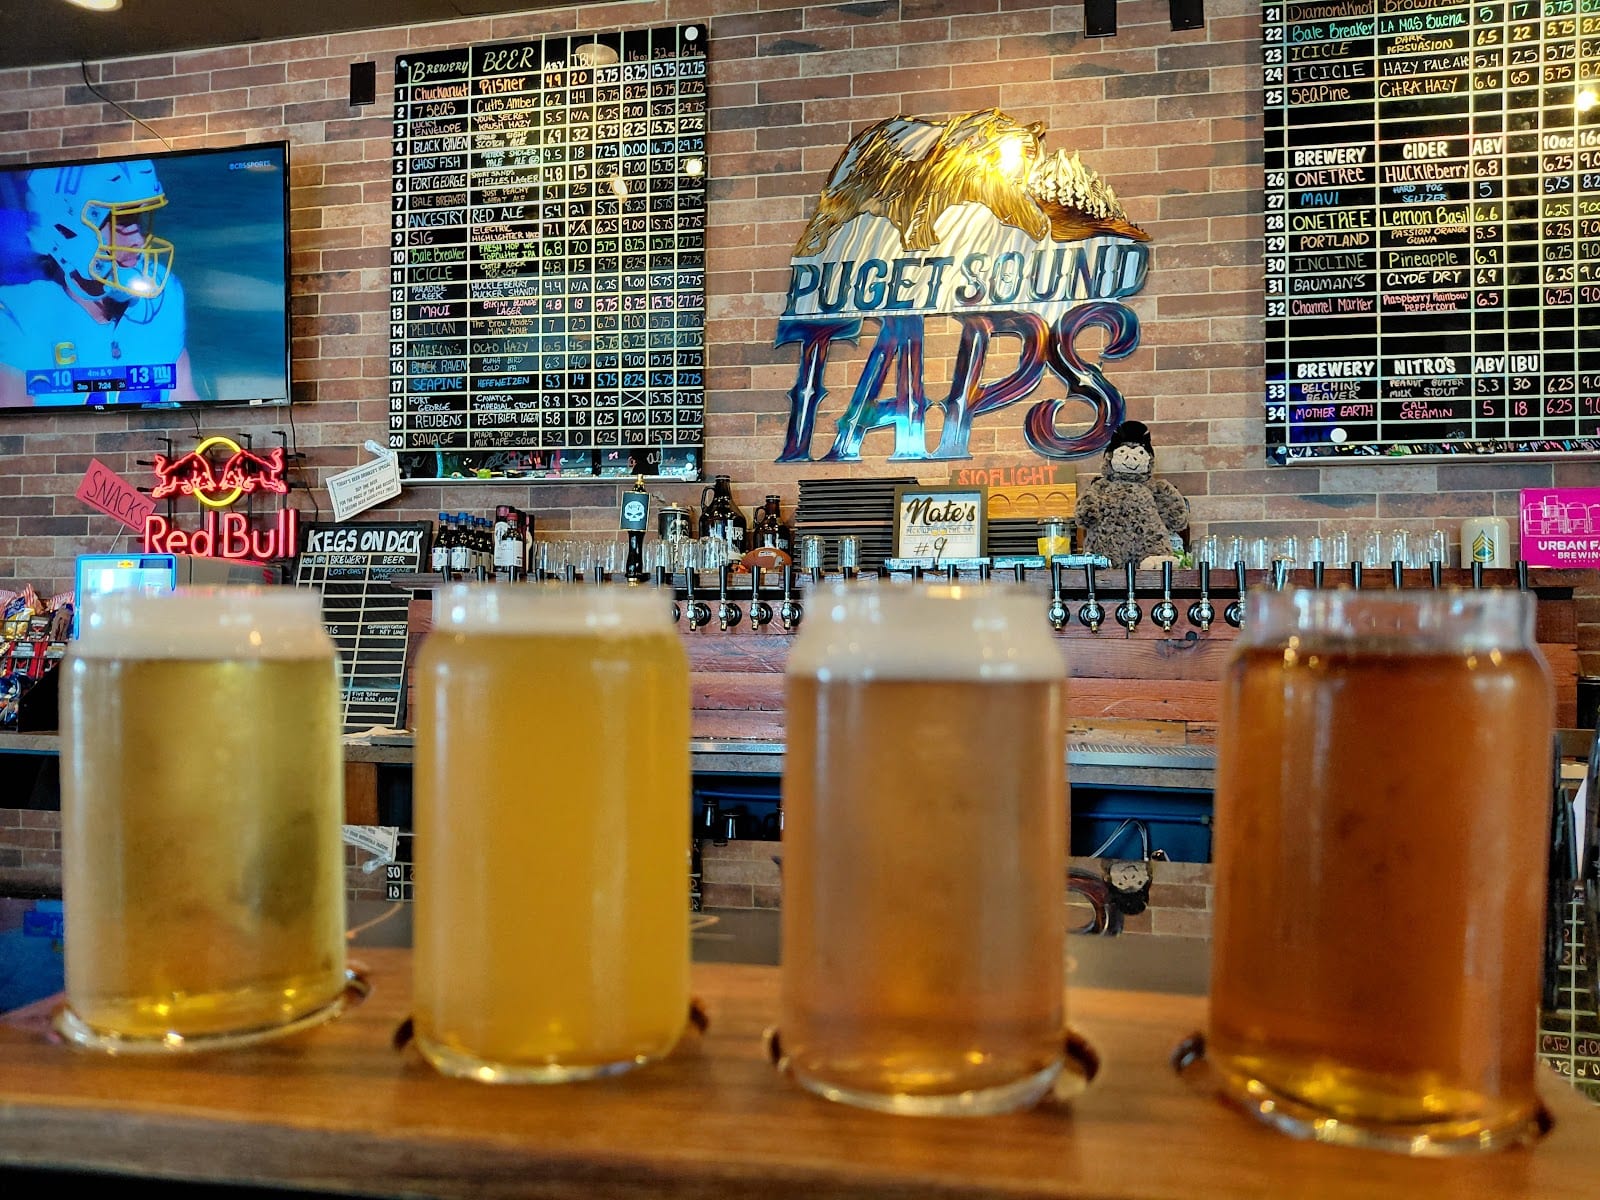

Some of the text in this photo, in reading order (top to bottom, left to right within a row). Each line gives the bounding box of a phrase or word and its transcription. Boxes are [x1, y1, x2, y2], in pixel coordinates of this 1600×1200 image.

[1265, 4, 1528, 42] 22 Bale LA 5 17
[1266, 8, 1280, 21] 21
[1265, 26, 1531, 63] 23 ICICLE PERSUASION 22
[1395, 34, 1425, 45] DARK
[483, 46, 534, 72] BEER
[1265, 50, 1538, 82] 24 ICICLE HAZY 25
[397, 71, 588, 101] 1 Chuckanut 20
[1265, 71, 1529, 104] 25 HAZY 65
[397, 90, 586, 119] 2 44
[396, 122, 462, 137] 3 ENVELOPE
[395, 142, 403, 155] 4
[414, 139, 441, 154] BLACK
[443, 136, 469, 152] RAVEN
[572, 127, 589, 141] 32
[1294, 146, 1367, 167] BREWERY
[1402, 141, 1448, 160] CIDER
[1473, 137, 1503, 156] ABV
[396, 156, 461, 174] 5 GHOST FISH
[395, 180, 404, 192] 6
[411, 176, 432, 191] FORT
[432, 172, 466, 189] GEORGE
[1266, 173, 1285, 187] 26
[395, 197, 404, 210] 7
[412, 195, 434, 208] BALE
[436, 194, 467, 207] BREAKER
[1267, 182, 1493, 208] 27 MAUI 5
[395, 204, 585, 228] 8 ANCESTRY RED ALE 21
[1266, 206, 1470, 231] 28 ONETREE Lemon Basil
[394, 230, 434, 246] 9 SIG
[1266, 237, 1285, 251] 29
[1300, 233, 1370, 250] PORTLAND
[1391, 227, 1432, 239] PASSION
[393, 251, 405, 264] 10
[1267, 258, 1285, 273] 30
[1294, 253, 1367, 272] INCLINE
[1389, 251, 1458, 269] Pineapple
[392, 266, 455, 283] 11 ICICLE
[784, 242, 1151, 317] PUGET SOUND
[1268, 279, 1283, 293] 31
[1386, 271, 1430, 286] CLYDE
[1433, 270, 1462, 284] DRY
[392, 289, 404, 302] 12
[392, 307, 404, 320] 13
[419, 304, 451, 319] MAUI
[1268, 302, 1286, 316] 32
[1292, 298, 1333, 315] Channel
[392, 322, 456, 338] 14 PELICAN
[391, 343, 404, 356] 15
[130, 366, 150, 384] 13
[391, 361, 404, 374] 16
[1297, 361, 1375, 379] BREWERY
[1475, 356, 1505, 374] ABV
[1511, 354, 1538, 373] IBU
[52, 370, 72, 387] 10
[391, 374, 585, 393] 17 SEAPINE 14
[773, 300, 1141, 464] TAPS
[1302, 381, 1361, 394] BELCHING
[1268, 385, 1286, 399] 33
[1306, 390, 1360, 401] BEAVER
[1423, 387, 1459, 397] STOUT
[1512, 377, 1532, 391] 30
[391, 398, 403, 411] 18
[417, 402, 451, 413] GEORGE
[513, 401, 538, 410] STOUT
[408, 396, 431, 406] FORT
[1401, 401, 1428, 411] CALI
[1268, 401, 1529, 421] 34 MOTHER EARTH CREAMIN 18
[391, 412, 586, 429] 19 REUBENS FESTBIER 18
[389, 435, 403, 448] 20
[412, 431, 455, 447] SAVAGE
[988, 464, 1058, 487] FLIGHT
[83, 469, 147, 528] SNACKS
[907, 496, 976, 525] Nate's
[145, 508, 298, 558] Red Bull
[307, 529, 423, 553] KEGS ON DECK
[1538, 540, 1600, 551] URBAN F
[330, 554, 405, 565] BREWERY BEER
[1558, 551, 1600, 559] BREWIN
